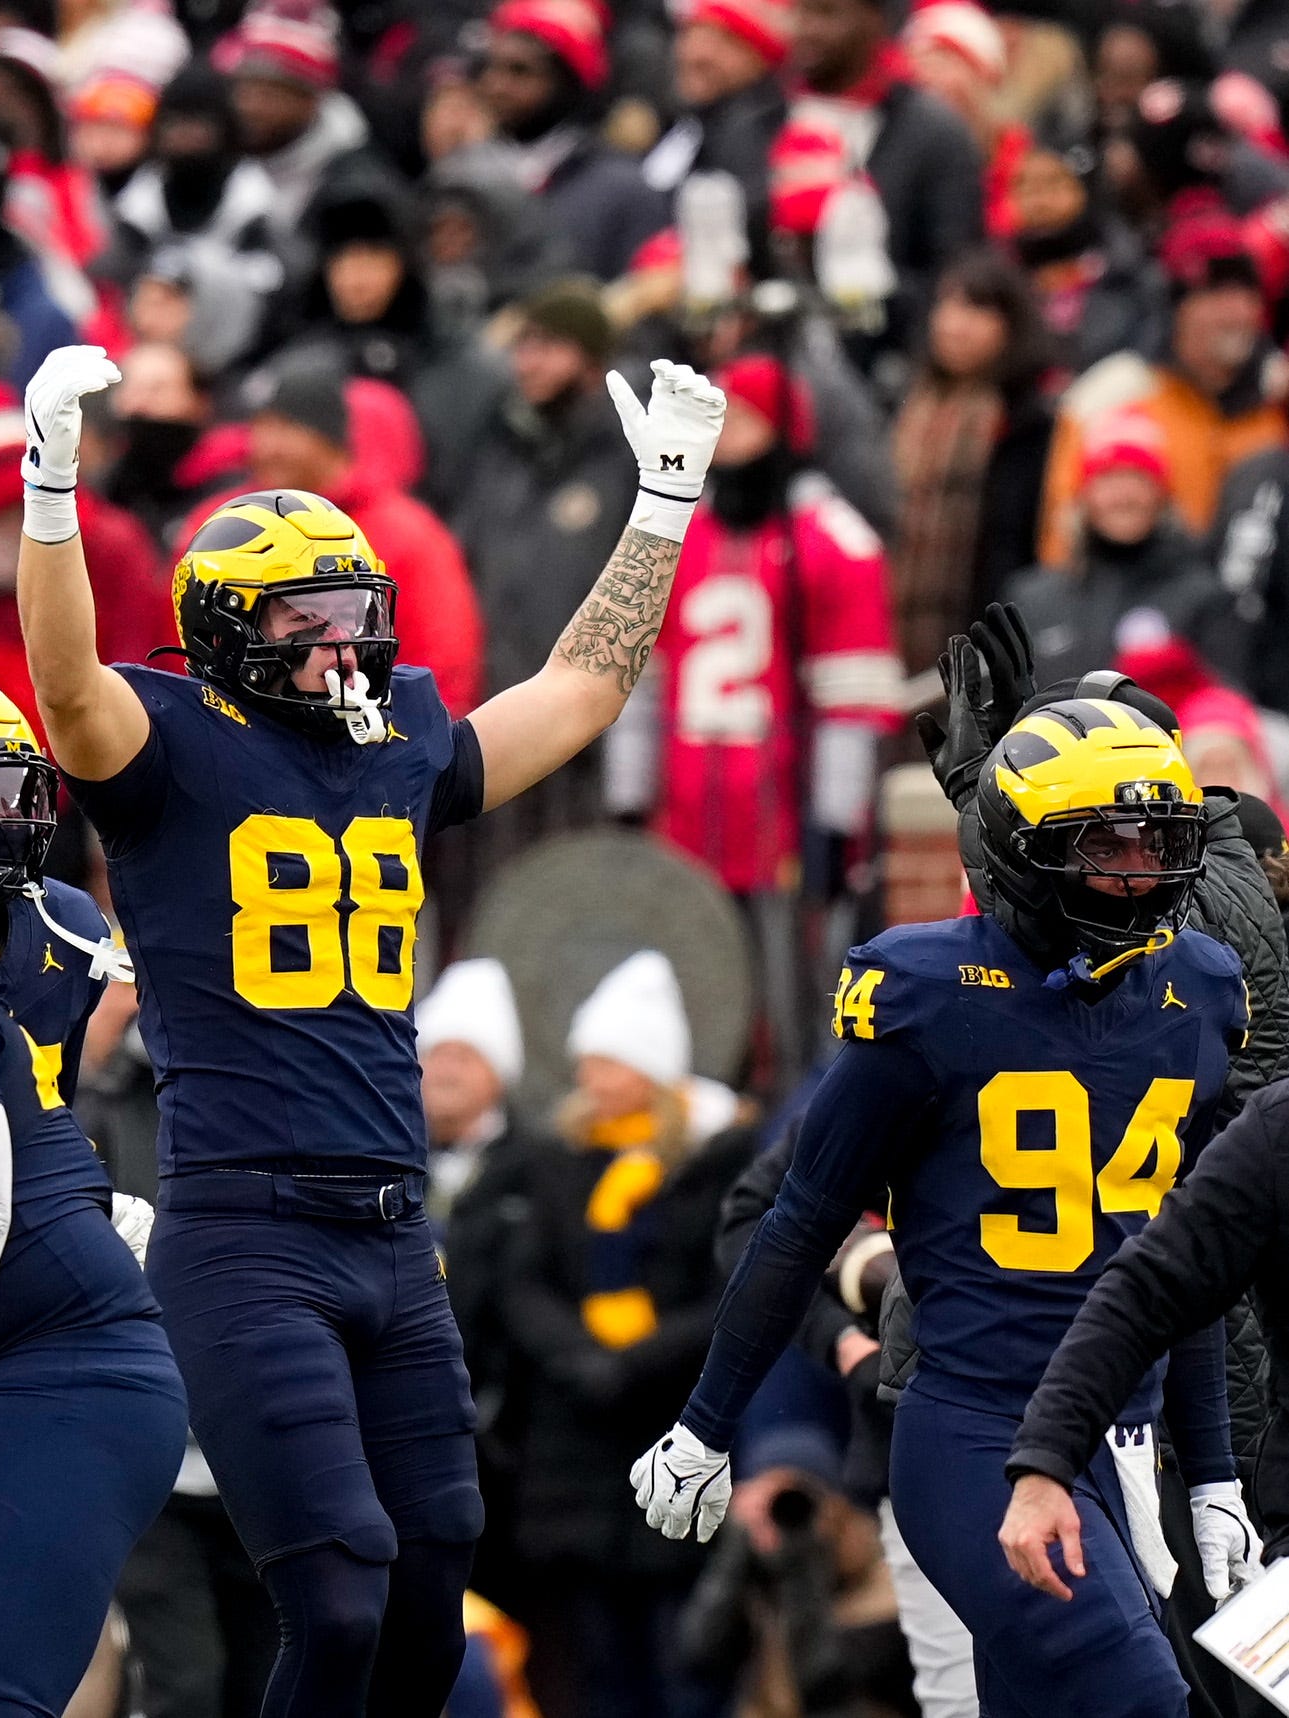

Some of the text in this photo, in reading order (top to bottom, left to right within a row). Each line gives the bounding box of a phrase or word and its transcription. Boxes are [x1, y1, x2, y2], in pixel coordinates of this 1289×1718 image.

[660, 454, 685, 471] M
[335, 557, 356, 572] M
[679, 572, 775, 743] 2
[5, 740, 21, 752] M
[229, 813, 425, 1012] 88
[977, 1070, 1196, 1273] 94
[1114, 1424, 1145, 1448] M
